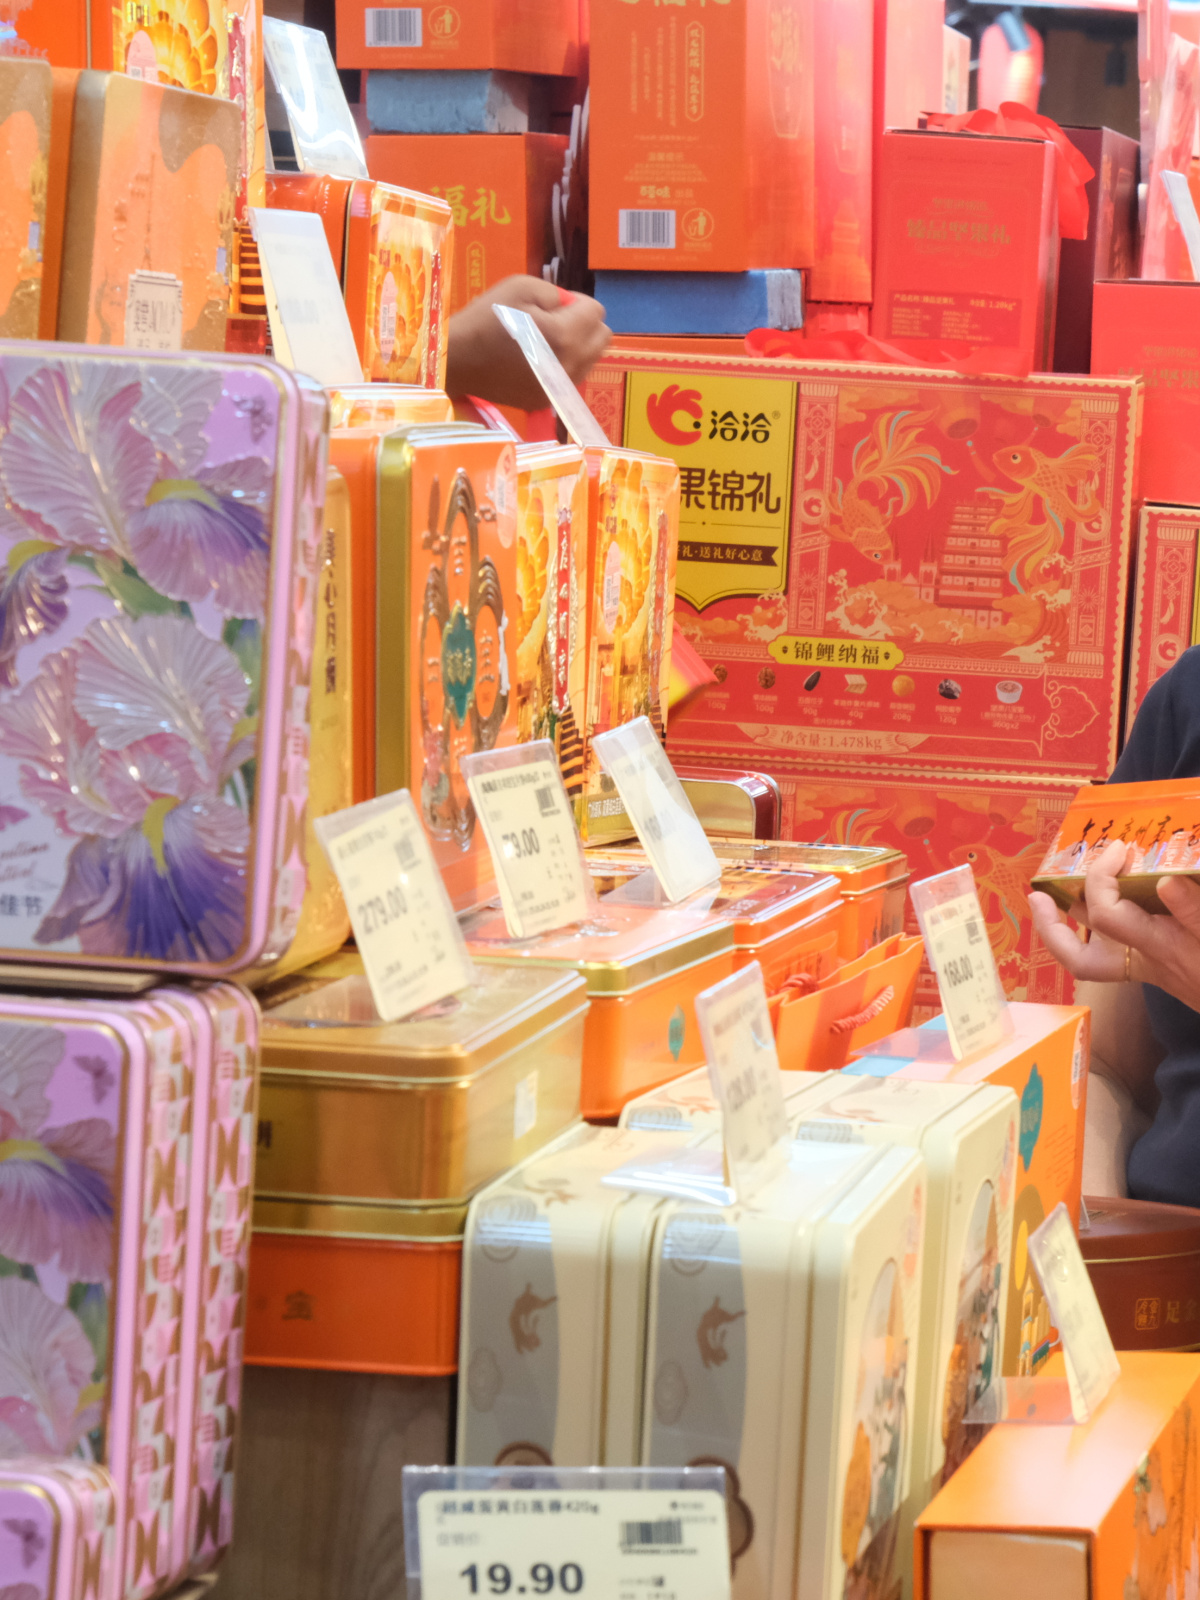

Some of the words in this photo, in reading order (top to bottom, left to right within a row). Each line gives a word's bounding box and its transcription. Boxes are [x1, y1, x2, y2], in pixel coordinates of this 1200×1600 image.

[709, 410, 772, 444] 洽洽
[679, 467, 781, 514] 果锦礼
[678, 544, 763, 562] 礼·送礼好心意
[793, 641, 880, 665] 锦鲤纳福
[755, 704, 774, 714] 100g
[357, 885, 409, 936] 279.00
[460, 1562, 585, 1595] 19.90
